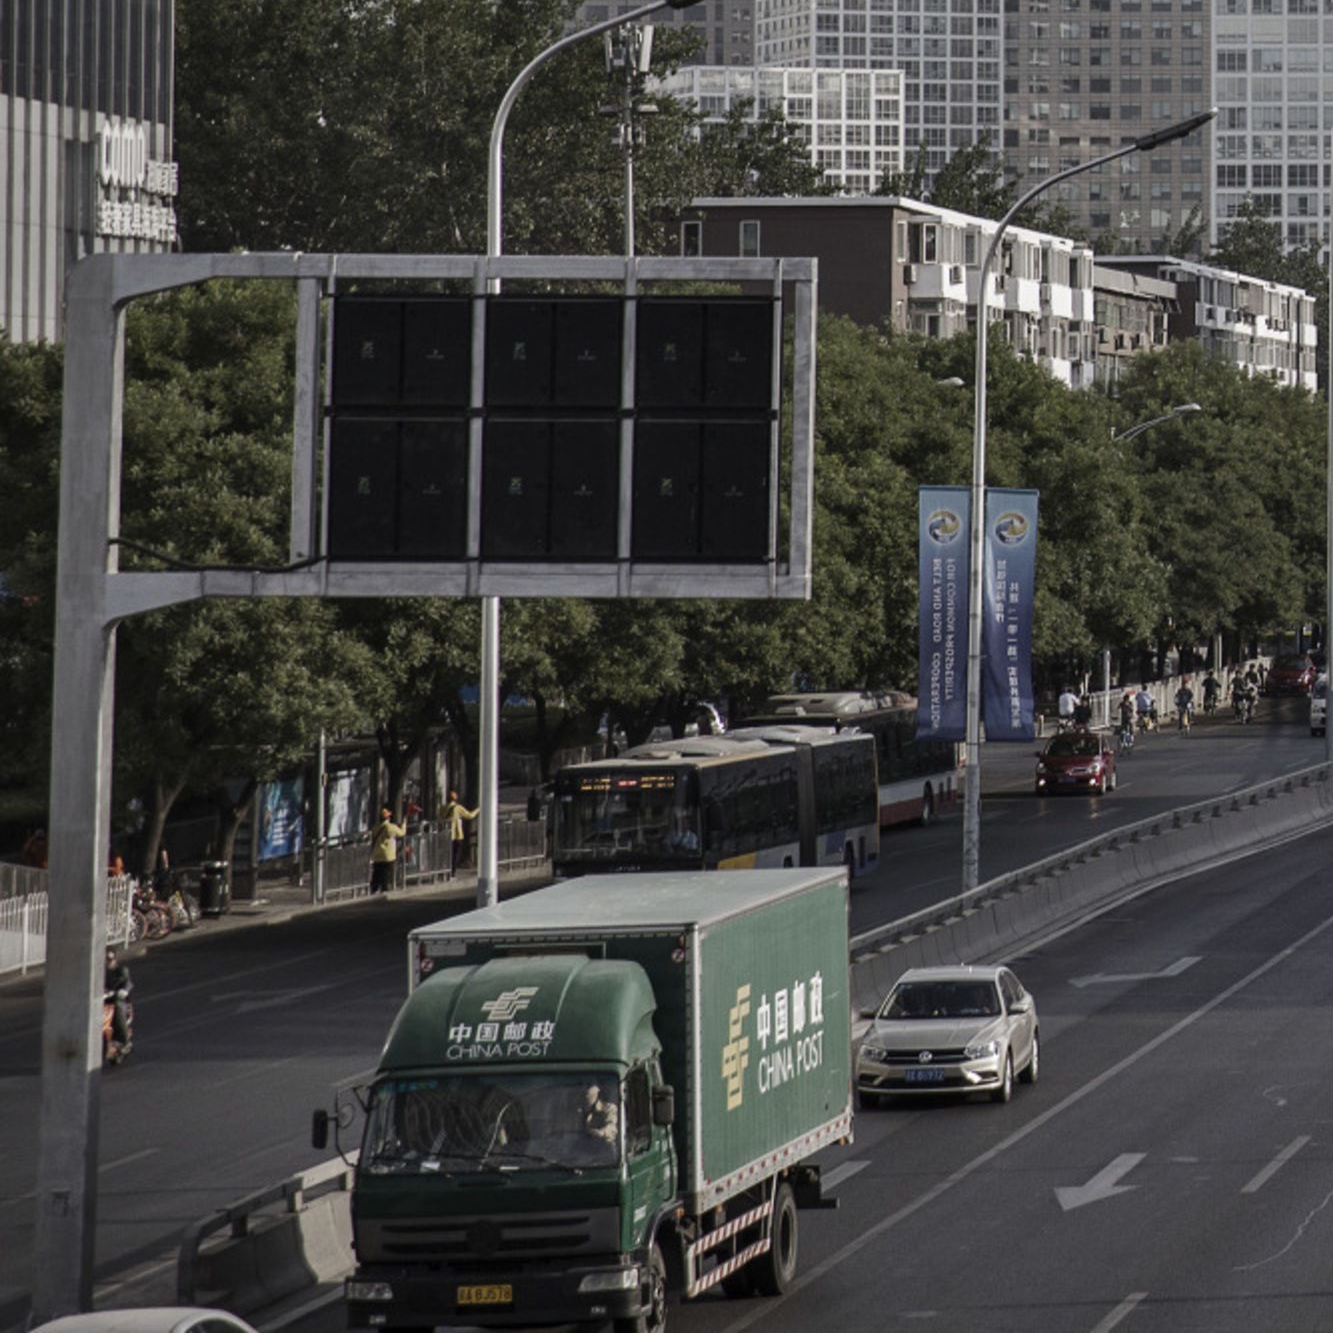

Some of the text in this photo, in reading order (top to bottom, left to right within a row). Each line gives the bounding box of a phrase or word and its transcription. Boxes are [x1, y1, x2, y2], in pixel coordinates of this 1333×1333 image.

[448, 1020, 555, 1043] 中国邮政
[757, 970, 824, 1051] 中国邮政
[446, 1041, 552, 1060] CHINA POST
[758, 1029, 824, 1094] CHINA POST
